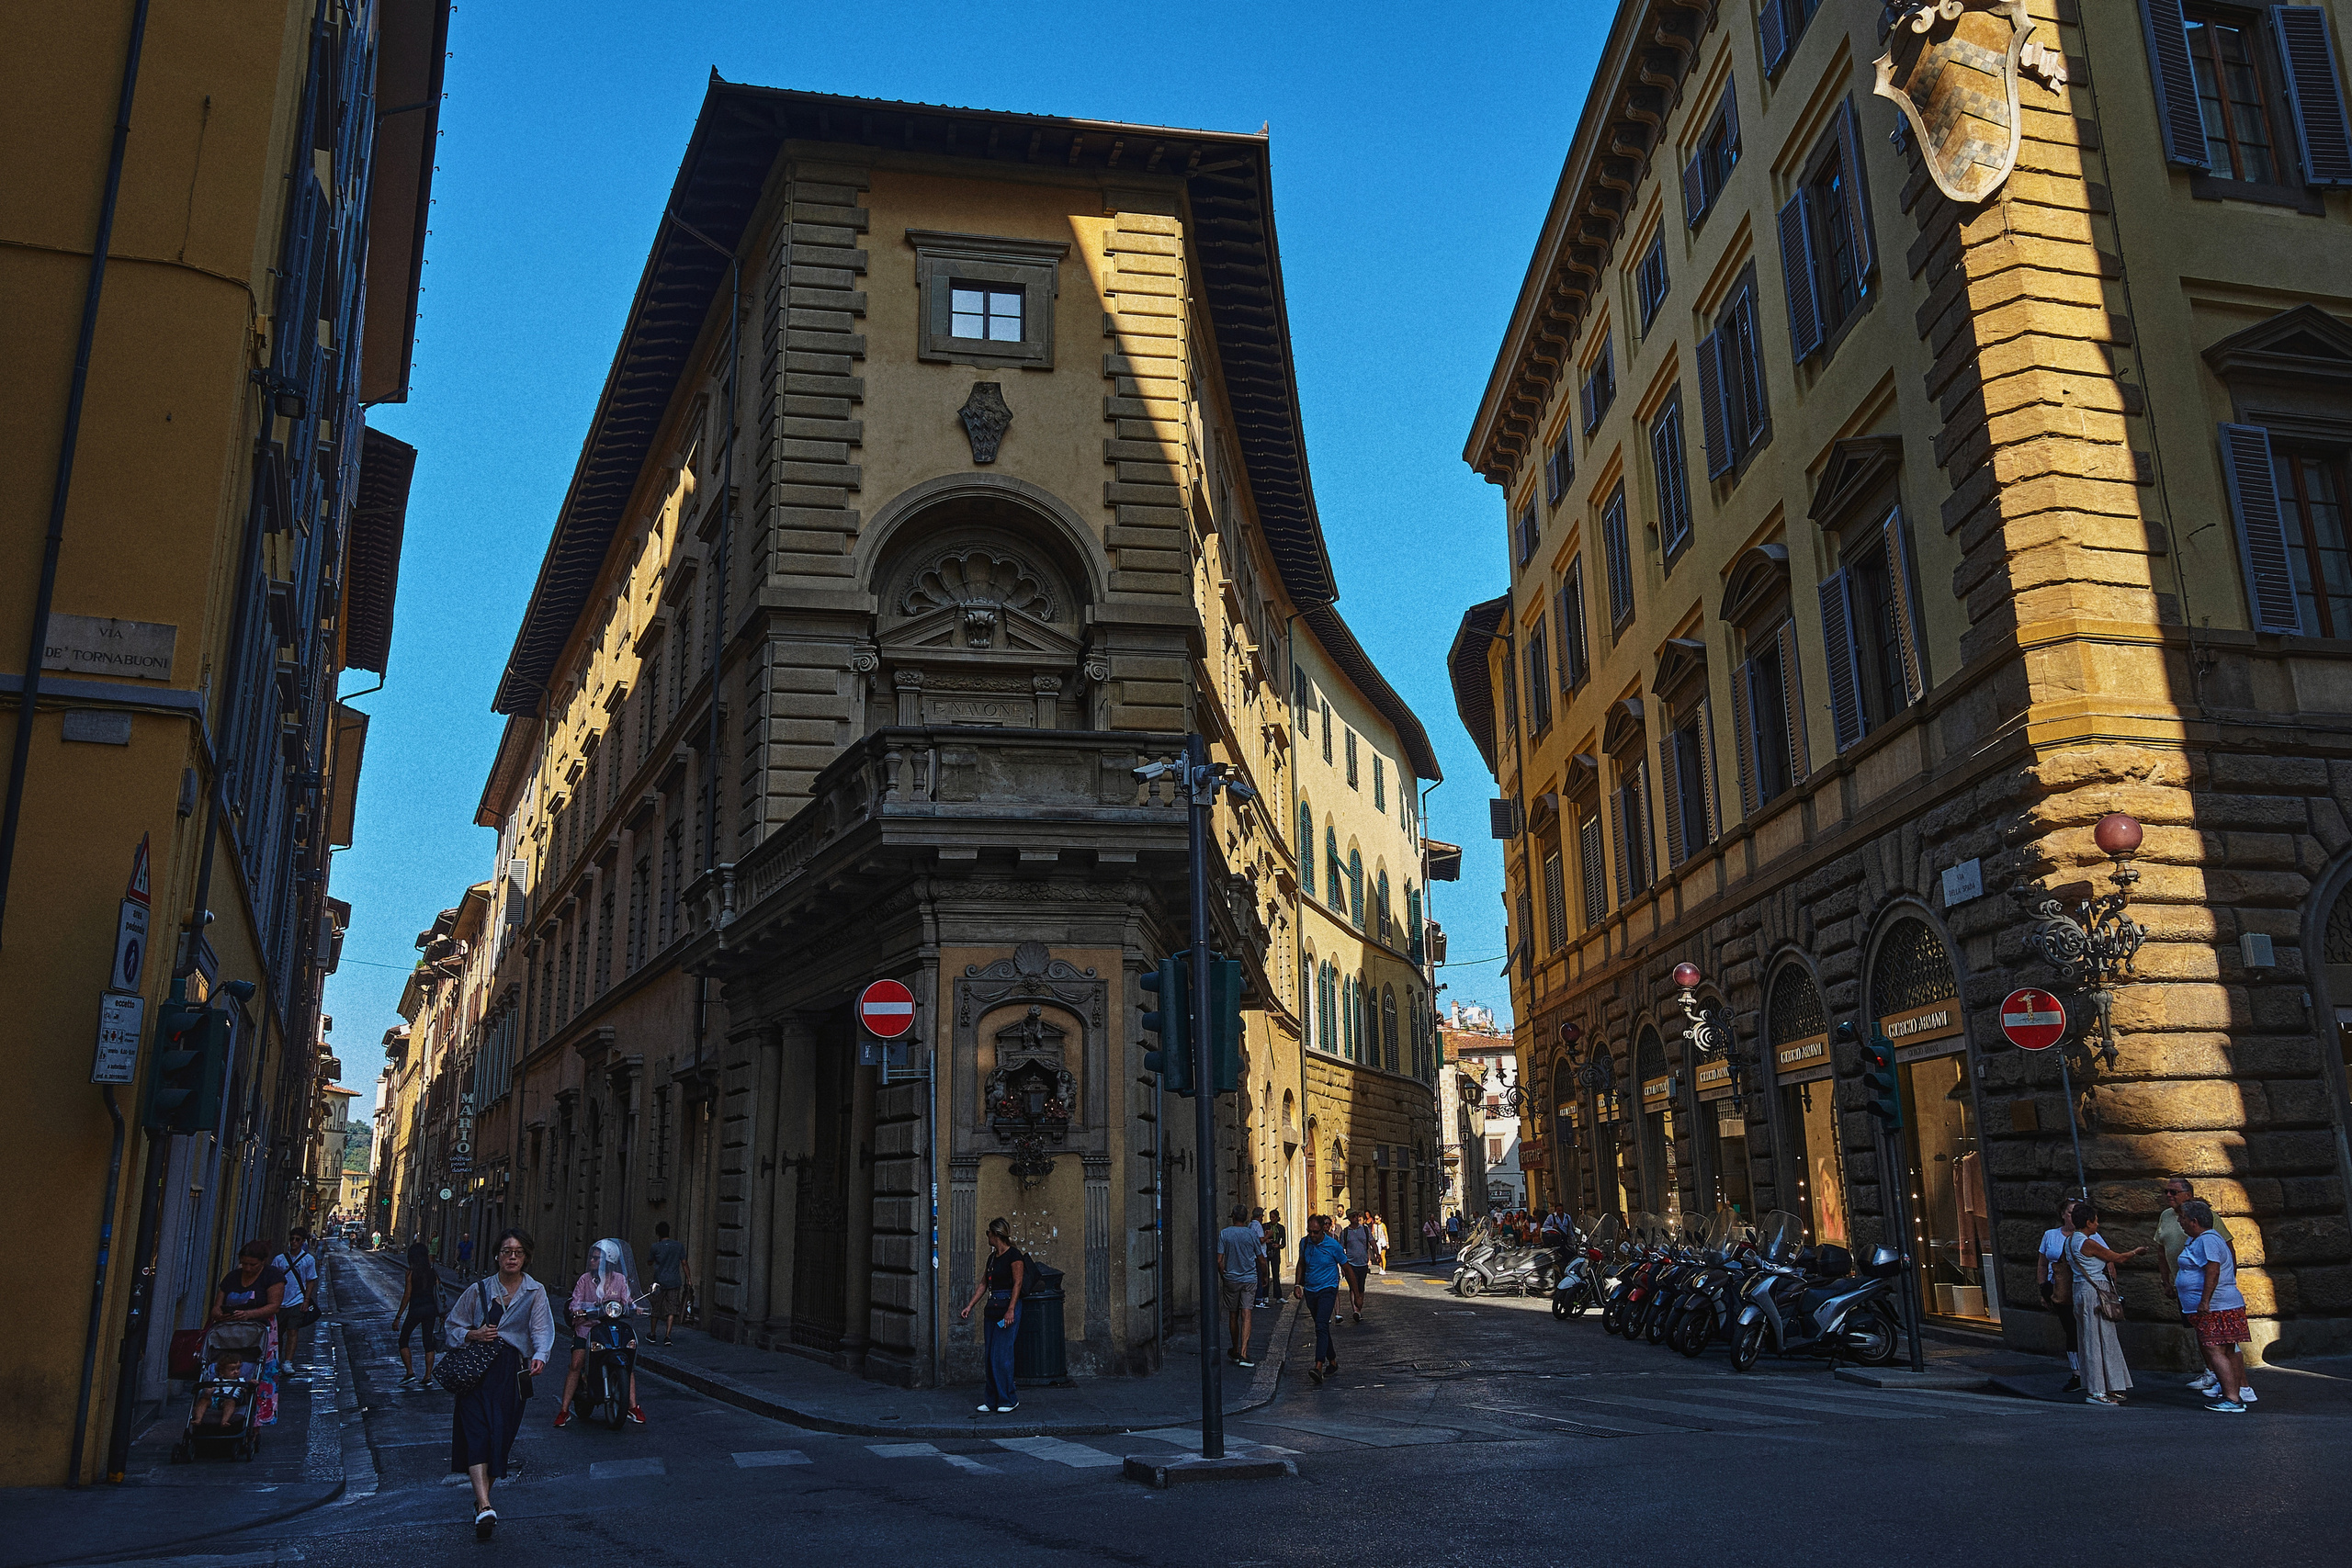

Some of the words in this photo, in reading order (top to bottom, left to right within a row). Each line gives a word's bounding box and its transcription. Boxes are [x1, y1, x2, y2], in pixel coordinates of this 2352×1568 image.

[98, 627, 124, 639] VIA
[73, 649, 168, 670] TORNABUONI
[950, 702, 1023, 717] NAVONE
[125, 921, 145, 935] pedonale
[114, 998, 135, 1009] eccetto
[1888, 1017, 1917, 1039] GIORGIO
[1917, 1010, 1949, 1032] ARMANI
[456, 1092, 474, 1153] MARIO
